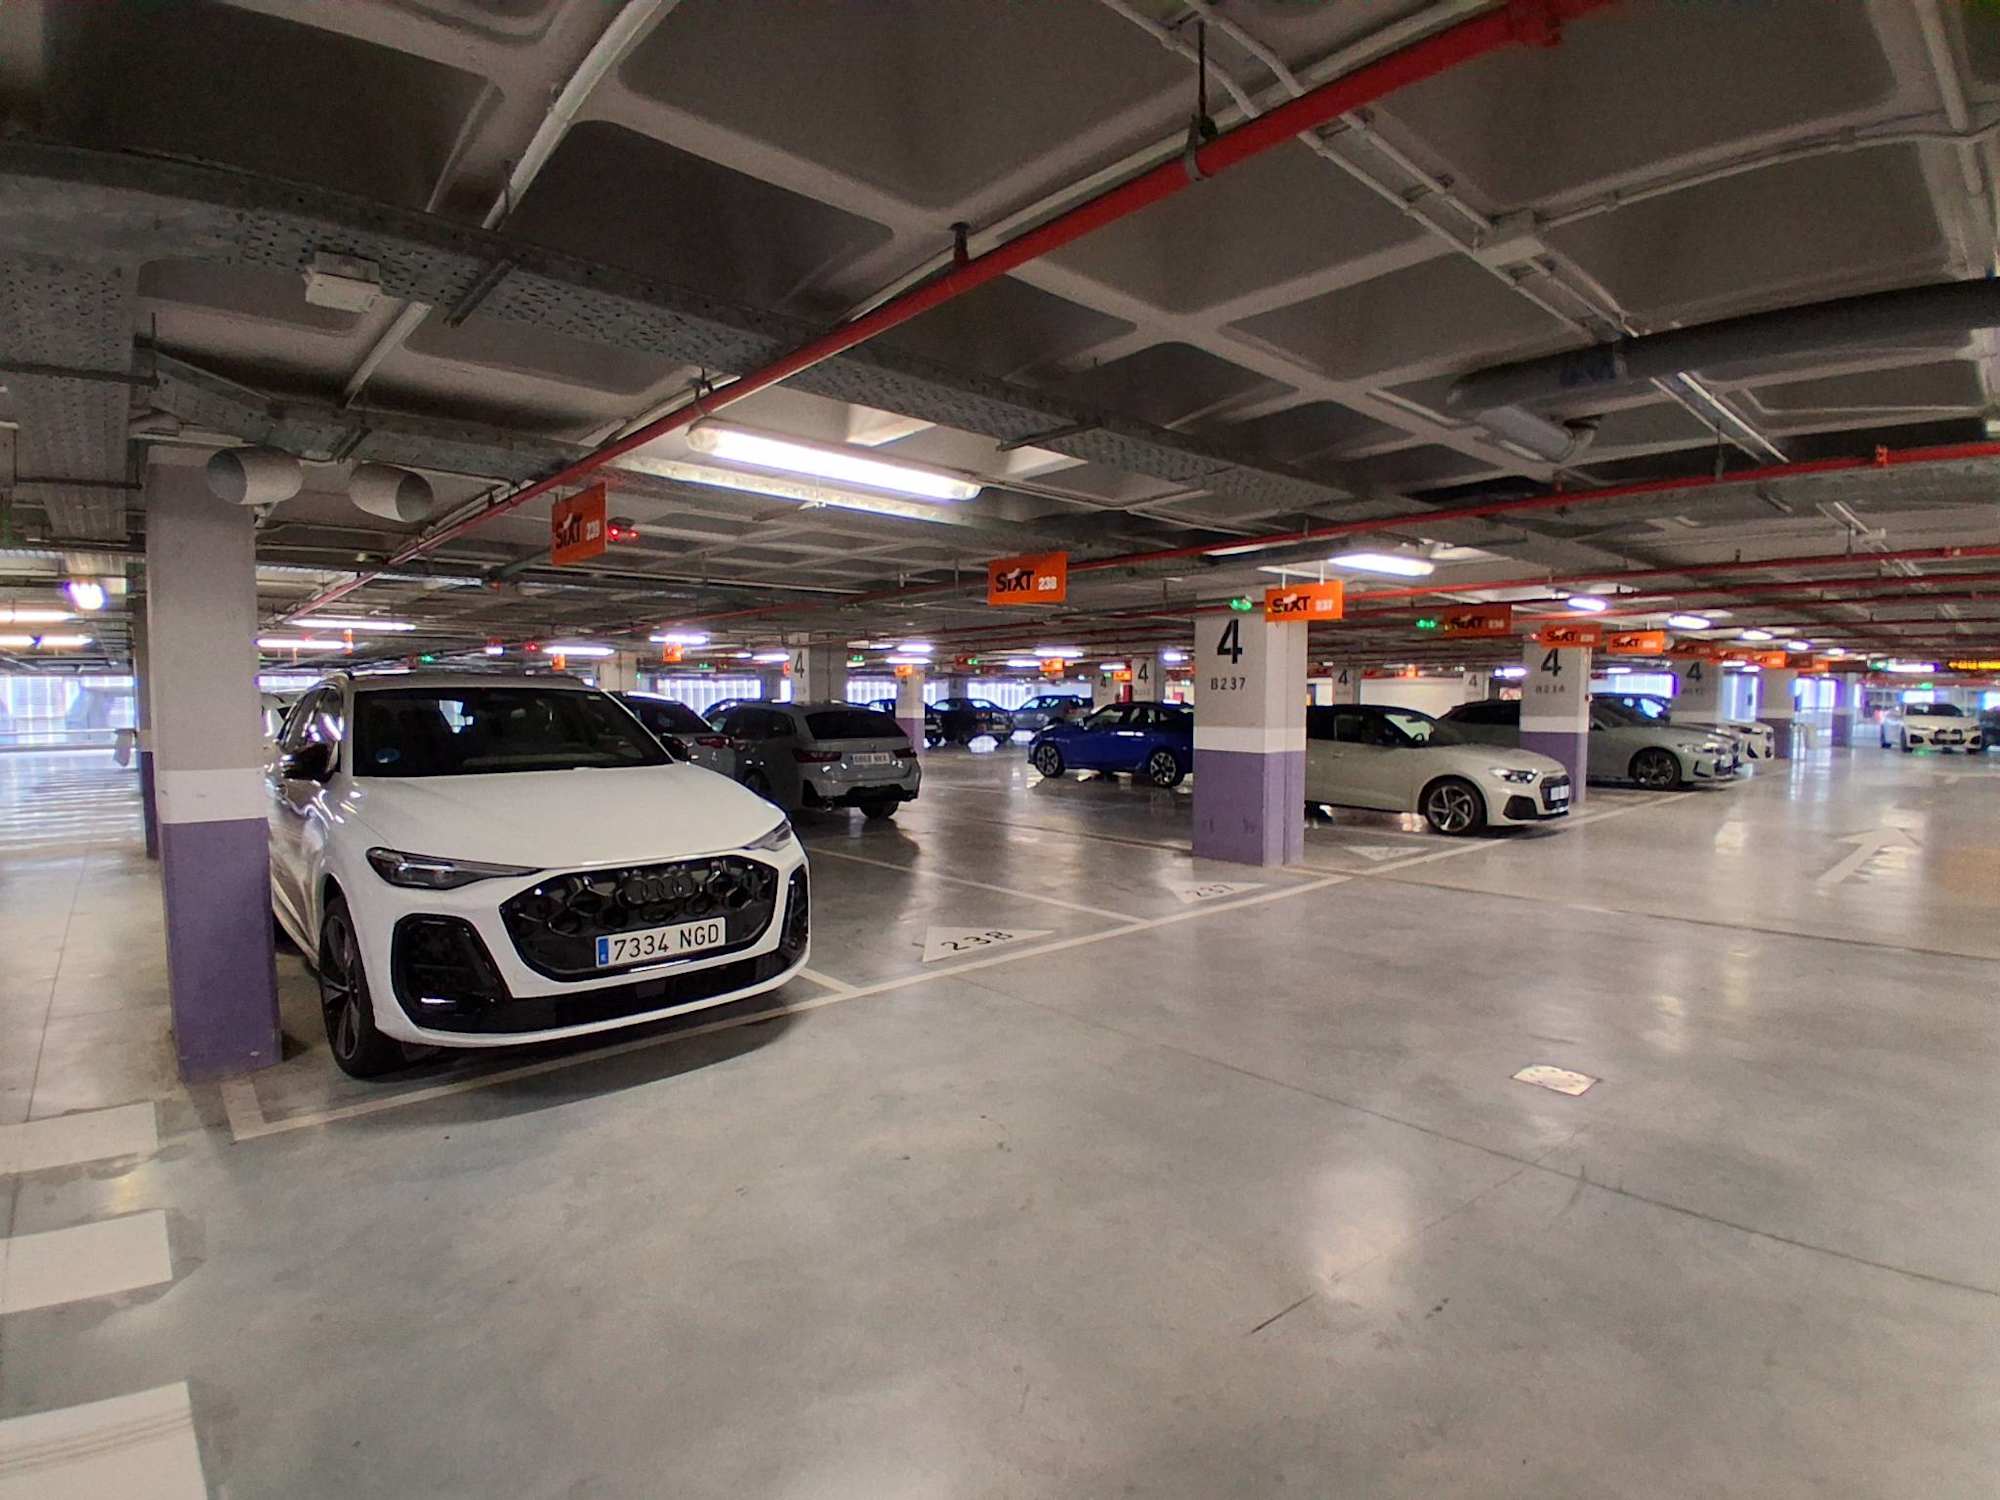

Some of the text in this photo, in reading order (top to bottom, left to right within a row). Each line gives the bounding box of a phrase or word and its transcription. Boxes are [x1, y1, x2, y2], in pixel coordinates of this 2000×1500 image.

[995, 568, 1035, 593] SIXT
[1272, 593, 1311, 614] SIXT
[1216, 618, 1243, 665] 4
[794, 650, 805, 678] 4
[1541, 648, 1562, 677] 4
[1686, 661, 1703, 682] 4
[1138, 663, 1148, 684] 4
[1210, 677, 1246, 691] B237
[1338, 668, 1348, 686] 4
[614, 924, 719, 961] 7334 NGD
[940, 930, 1014, 951] 238
